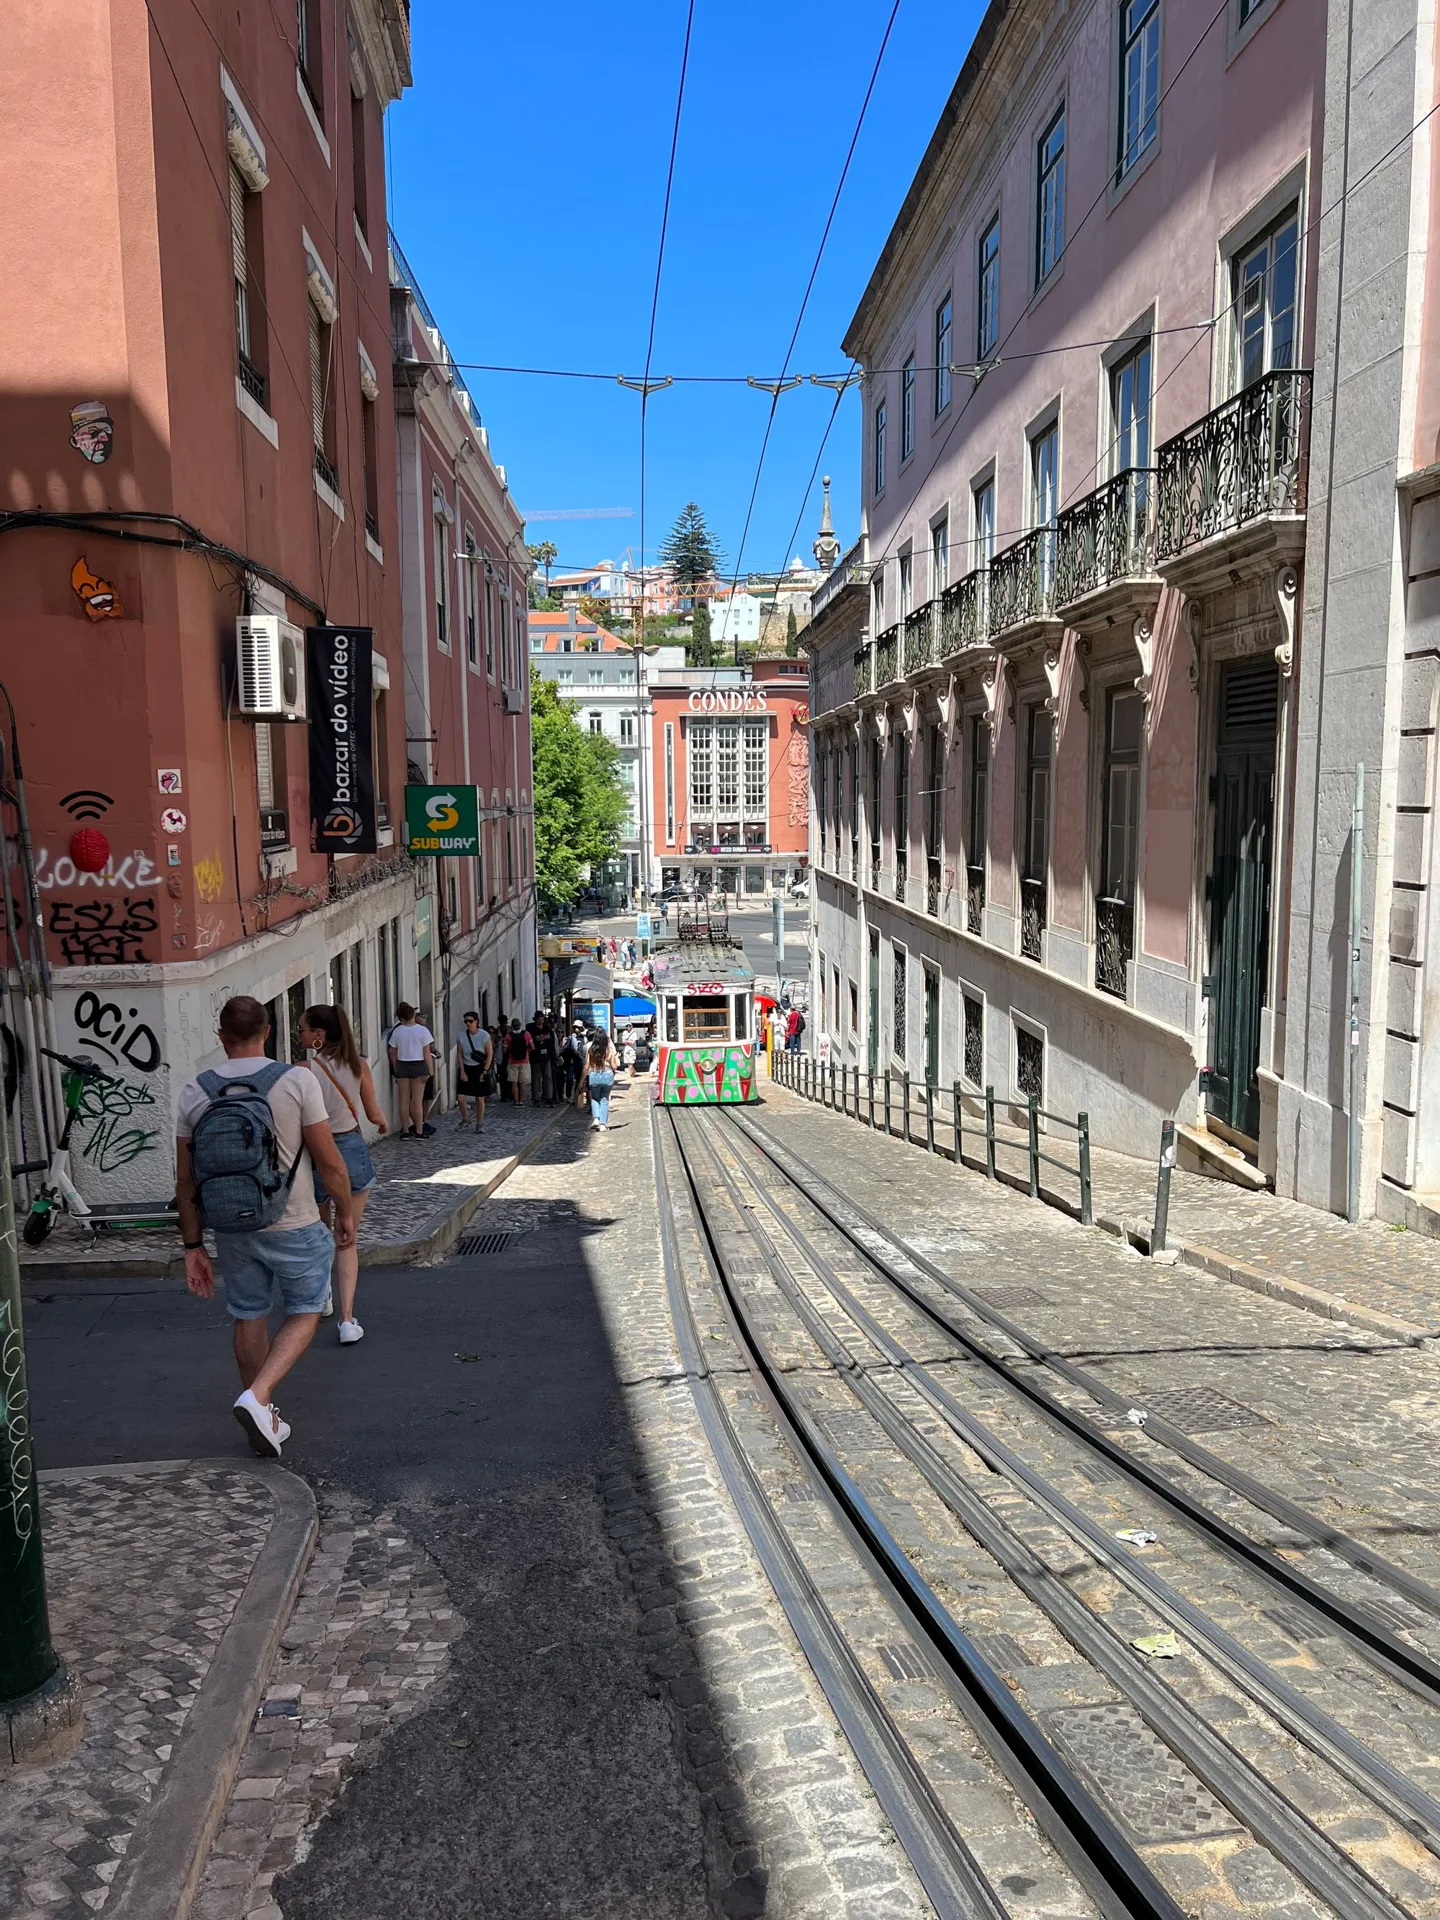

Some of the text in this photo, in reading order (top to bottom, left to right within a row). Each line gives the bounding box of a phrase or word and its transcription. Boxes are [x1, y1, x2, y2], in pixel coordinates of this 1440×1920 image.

[688, 691, 767, 711] CONDES
[328, 635, 351, 802] bazar do vídeo
[349, 730, 357, 752] OPTEC
[410, 837, 477, 850] SUBWAY
